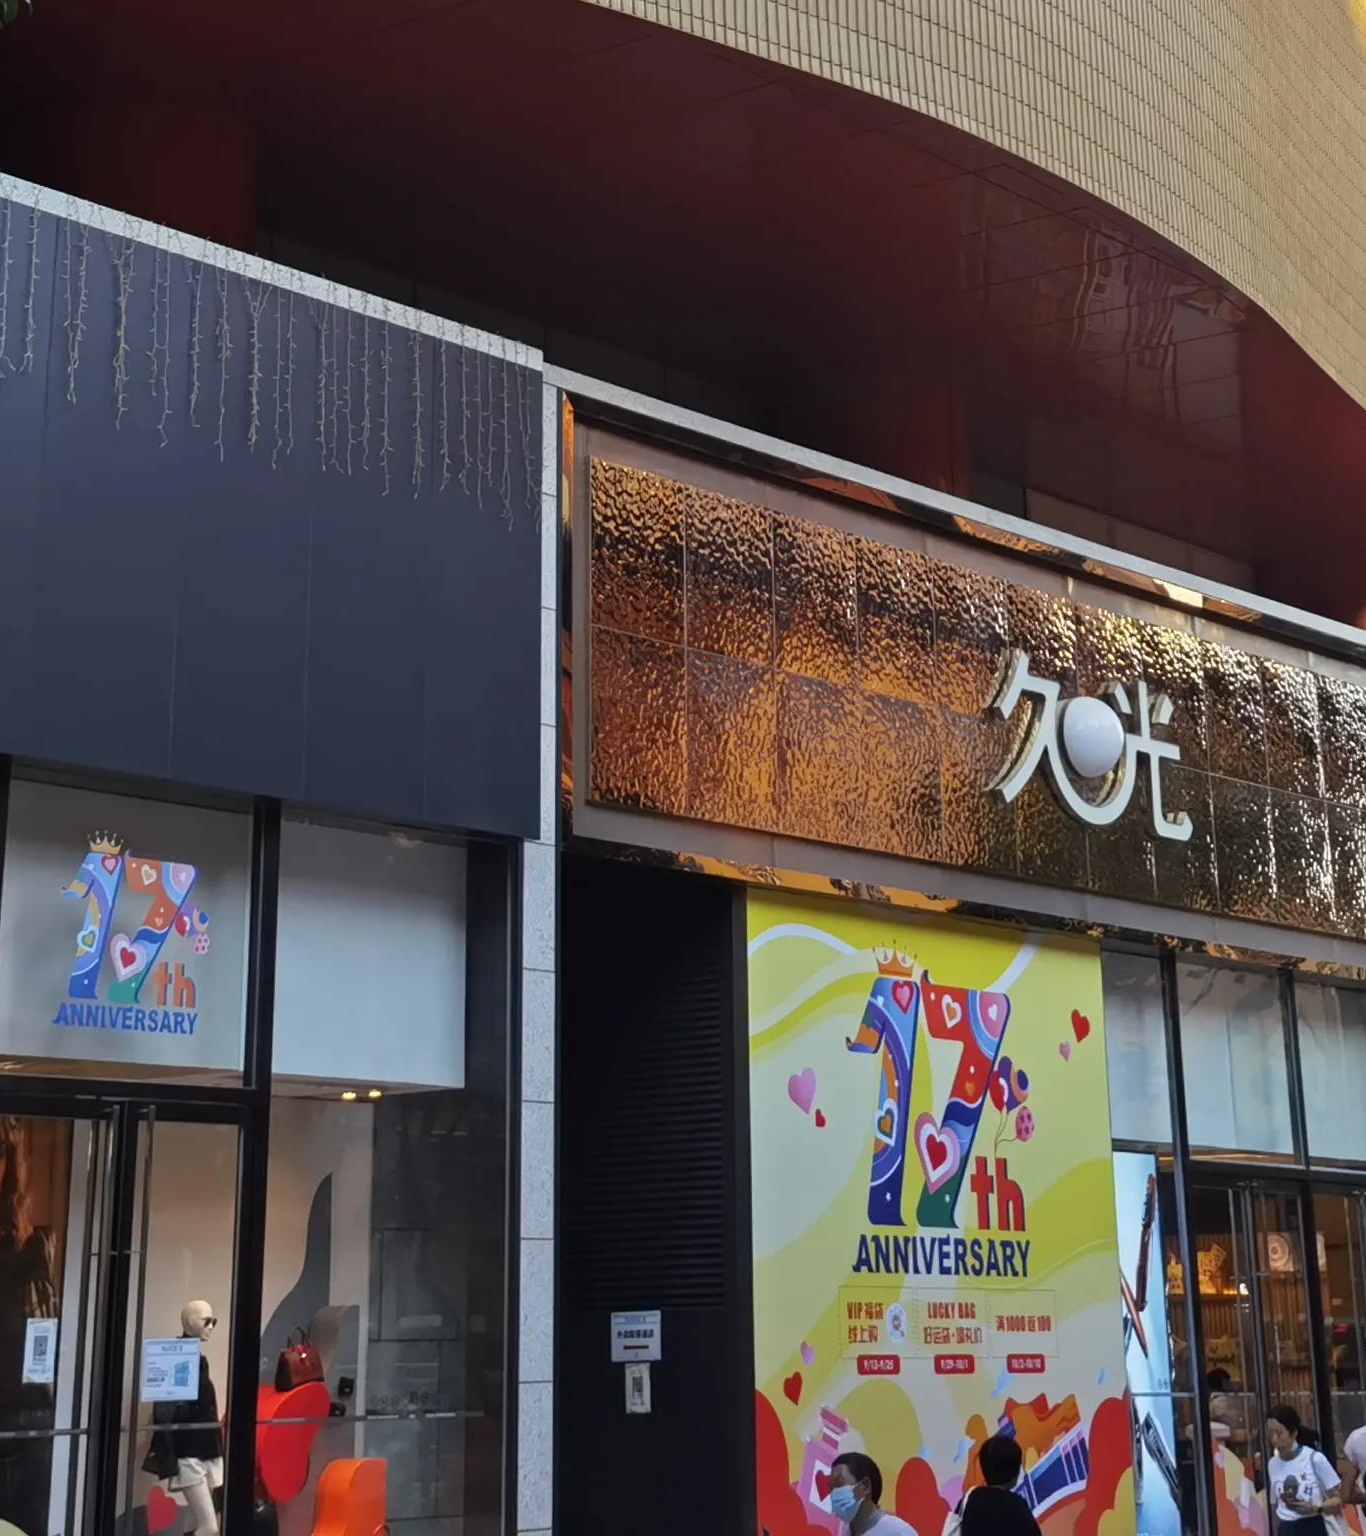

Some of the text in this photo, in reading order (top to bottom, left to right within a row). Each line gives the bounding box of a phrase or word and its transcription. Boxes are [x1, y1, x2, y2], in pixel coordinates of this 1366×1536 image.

[986, 649, 1193, 842] 久光
[53, 1001, 199, 1036] ANNIVERSARY
[852, 1233, 1031, 1278] ANNIVERSARY
[927, 1301, 955, 1320] LUCKY
